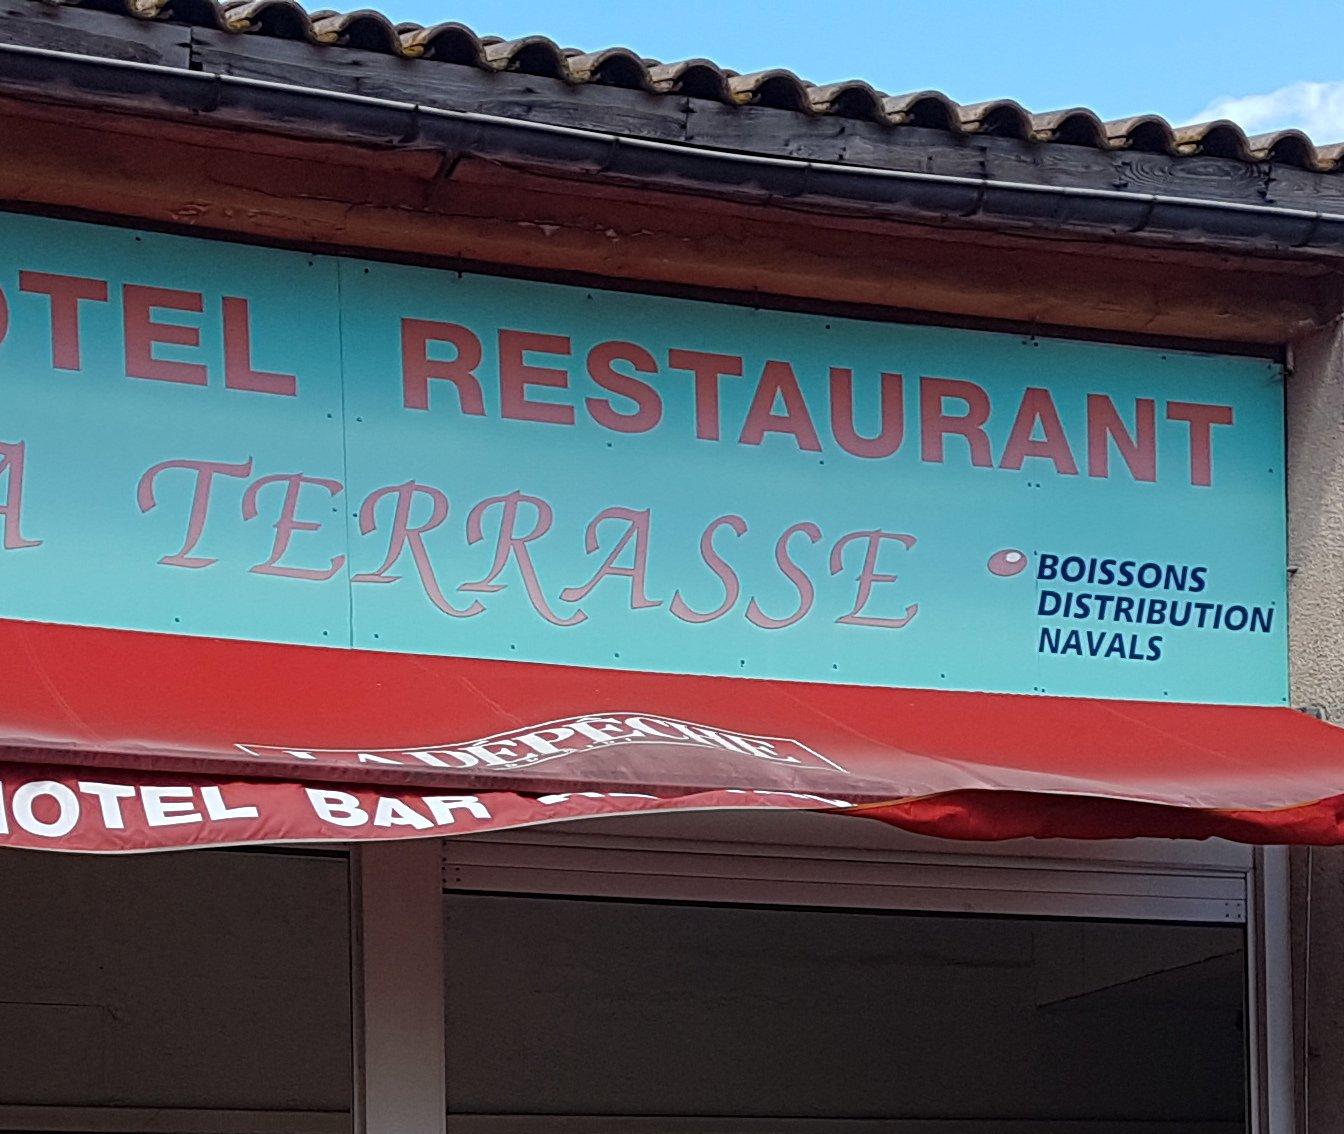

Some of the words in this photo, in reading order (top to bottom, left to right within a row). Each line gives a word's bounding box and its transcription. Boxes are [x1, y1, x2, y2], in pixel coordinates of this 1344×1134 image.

[401, 317, 1234, 488] RESTAURANT
[137, 456, 918, 629] TERRASSE
[1037, 554, 1208, 593] BOISSONS
[1037, 590, 1275, 633] DISTRIBUTION
[1038, 627, 1163, 661] NAVALS
[305, 787, 491, 829] BAR
